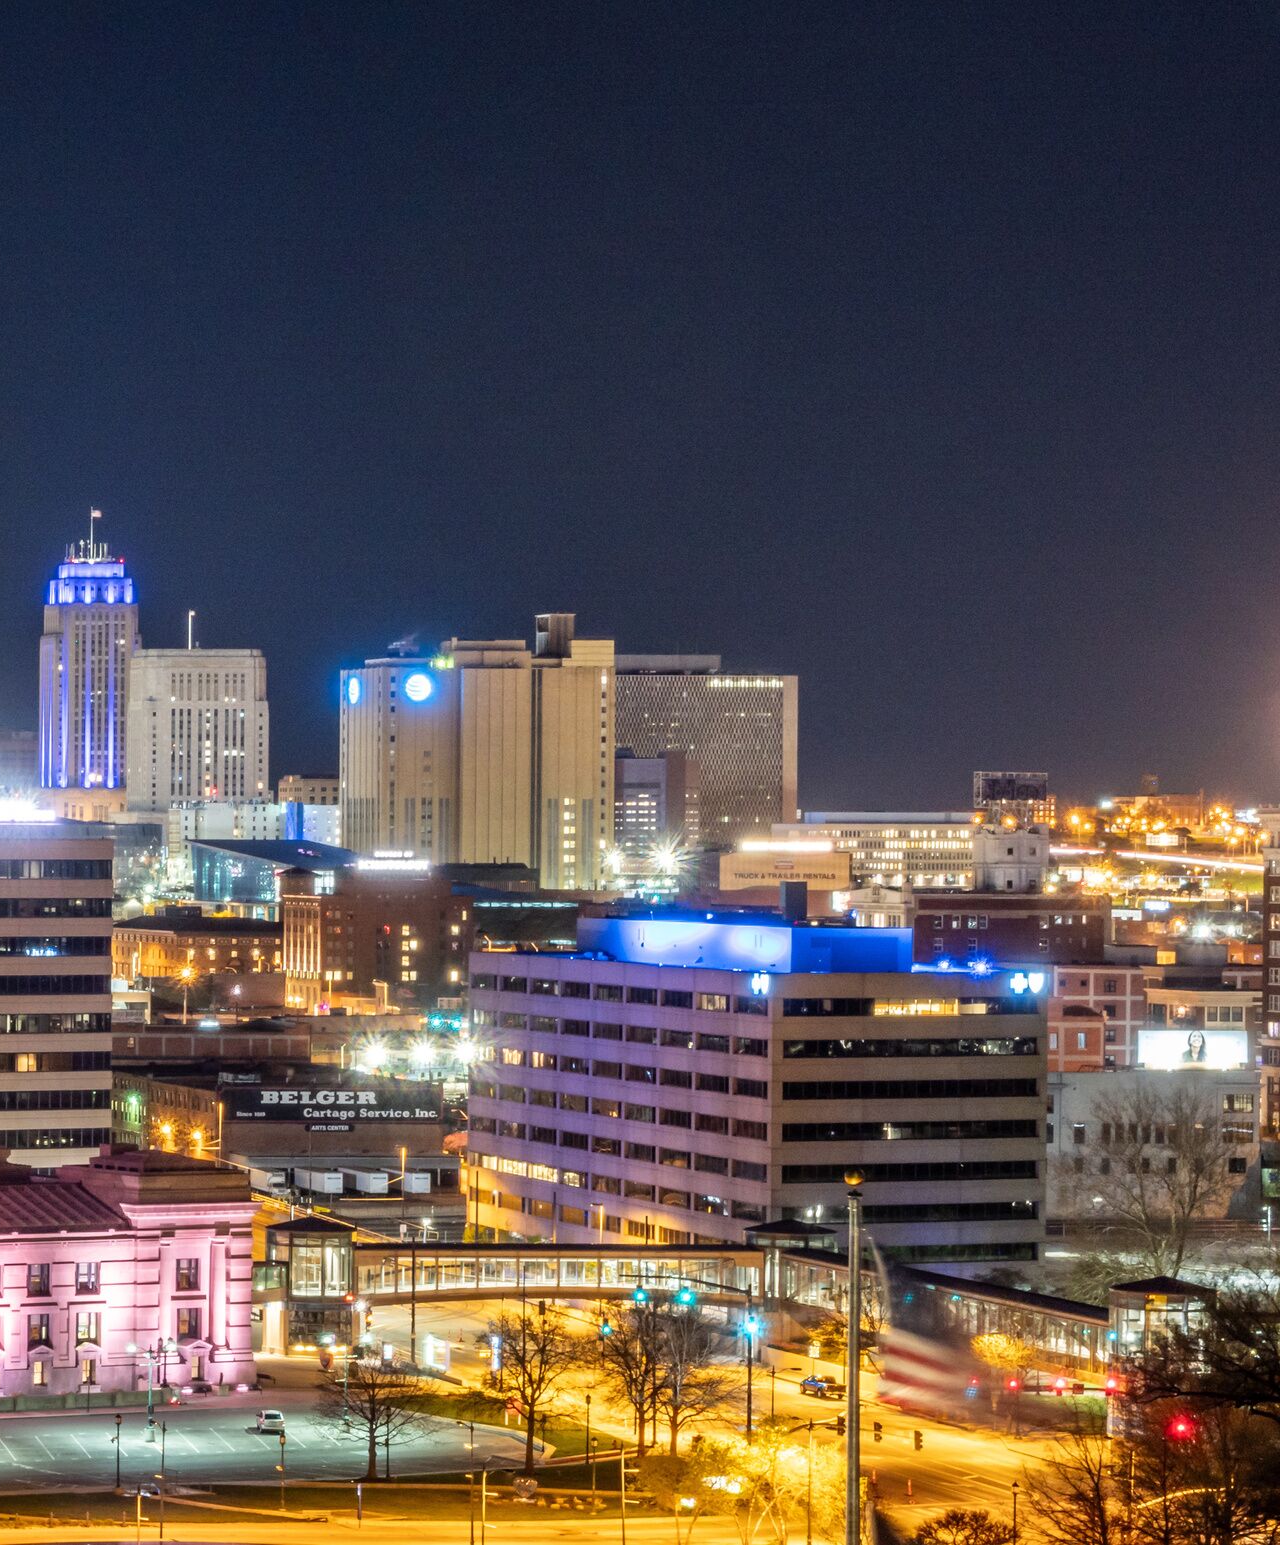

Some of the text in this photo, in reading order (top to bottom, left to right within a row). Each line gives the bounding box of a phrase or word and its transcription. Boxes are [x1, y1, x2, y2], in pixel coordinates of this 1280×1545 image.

[734, 872, 759, 880] TRUCK
[767, 872, 801, 880] TRAILER
[803, 872, 836, 880] RENTALS
[260, 1090, 378, 1105] BELGER
[303, 1107, 356, 1120] Cartage
